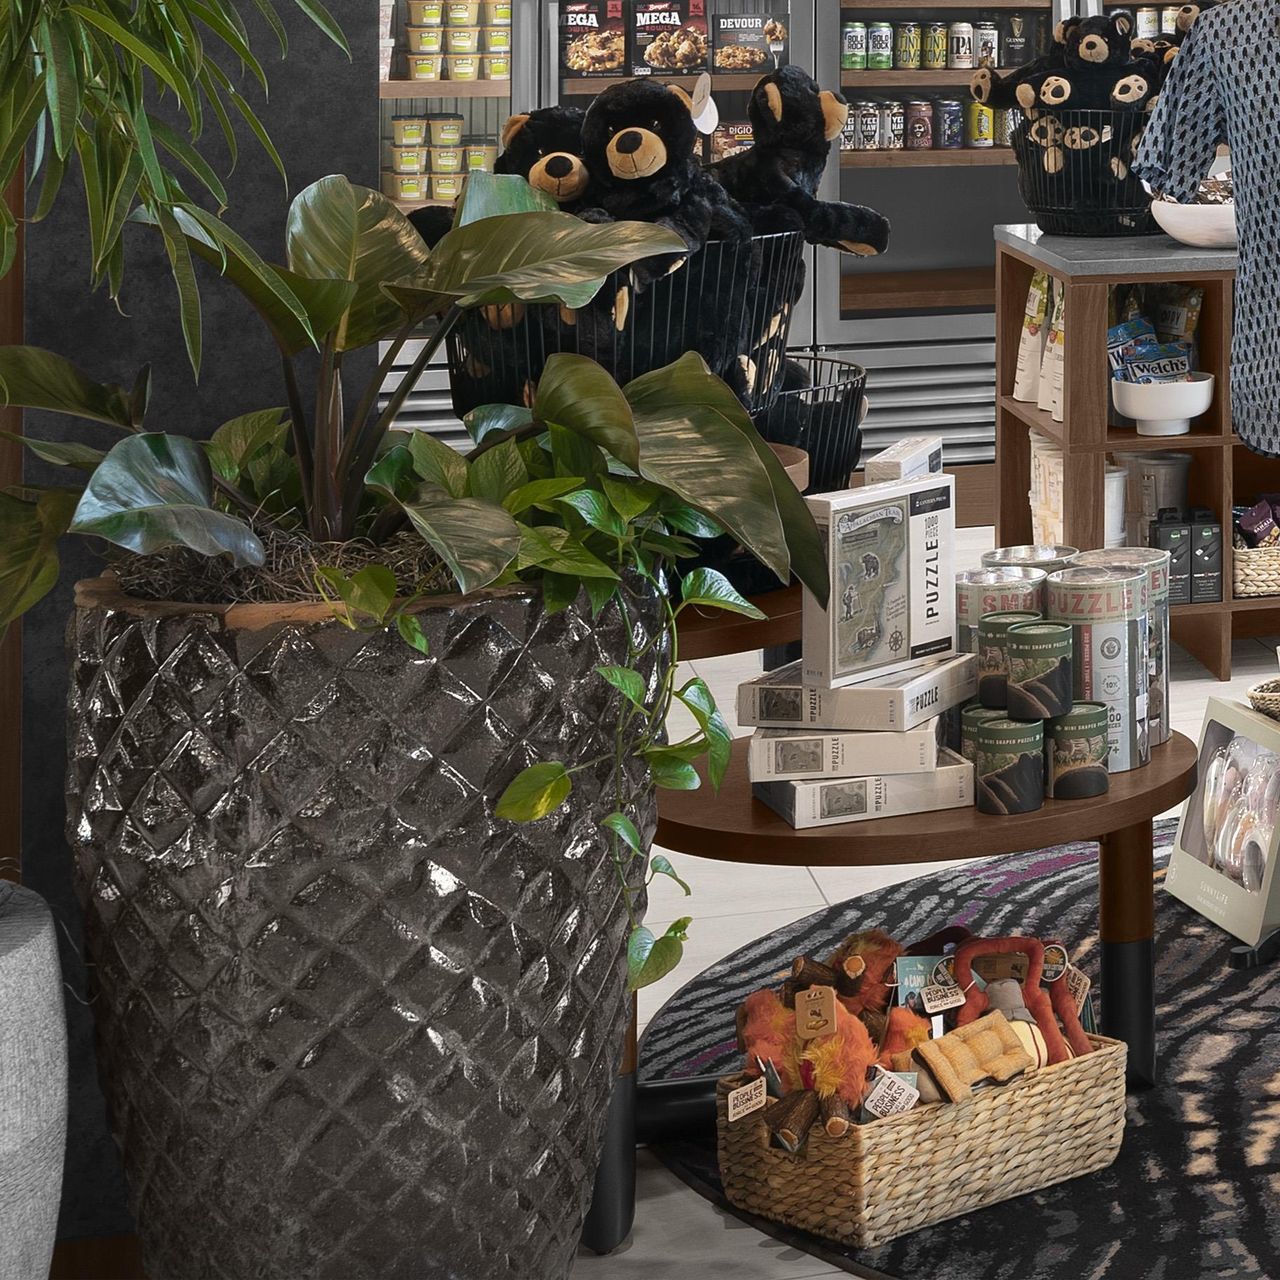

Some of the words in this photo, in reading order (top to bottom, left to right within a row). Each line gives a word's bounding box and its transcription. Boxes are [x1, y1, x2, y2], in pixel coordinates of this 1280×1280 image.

[636, 12, 681, 27] MEGA
[720, 18, 762, 29] DEVOUR
[847, 34, 864, 43] BOLD
[847, 41, 864, 50] ROCK
[872, 34, 889, 43] BOLD
[872, 41, 889, 50] ROCK
[952, 36, 972, 55] IPA
[1135, 359, 1187, 374] Welch's
[925, 538, 940, 619] PUZZLE
[916, 686, 939, 712] PUZZLE
[1109, 713, 1122, 722] 00
[832, 737, 840, 765] PUZZLE
[927, 991, 959, 1003] BUSINESS
[732, 1091, 763, 1110] BUSINESS
[872, 1088, 891, 1111] PEOPLE
[879, 1085, 906, 1117] BUSINESS
